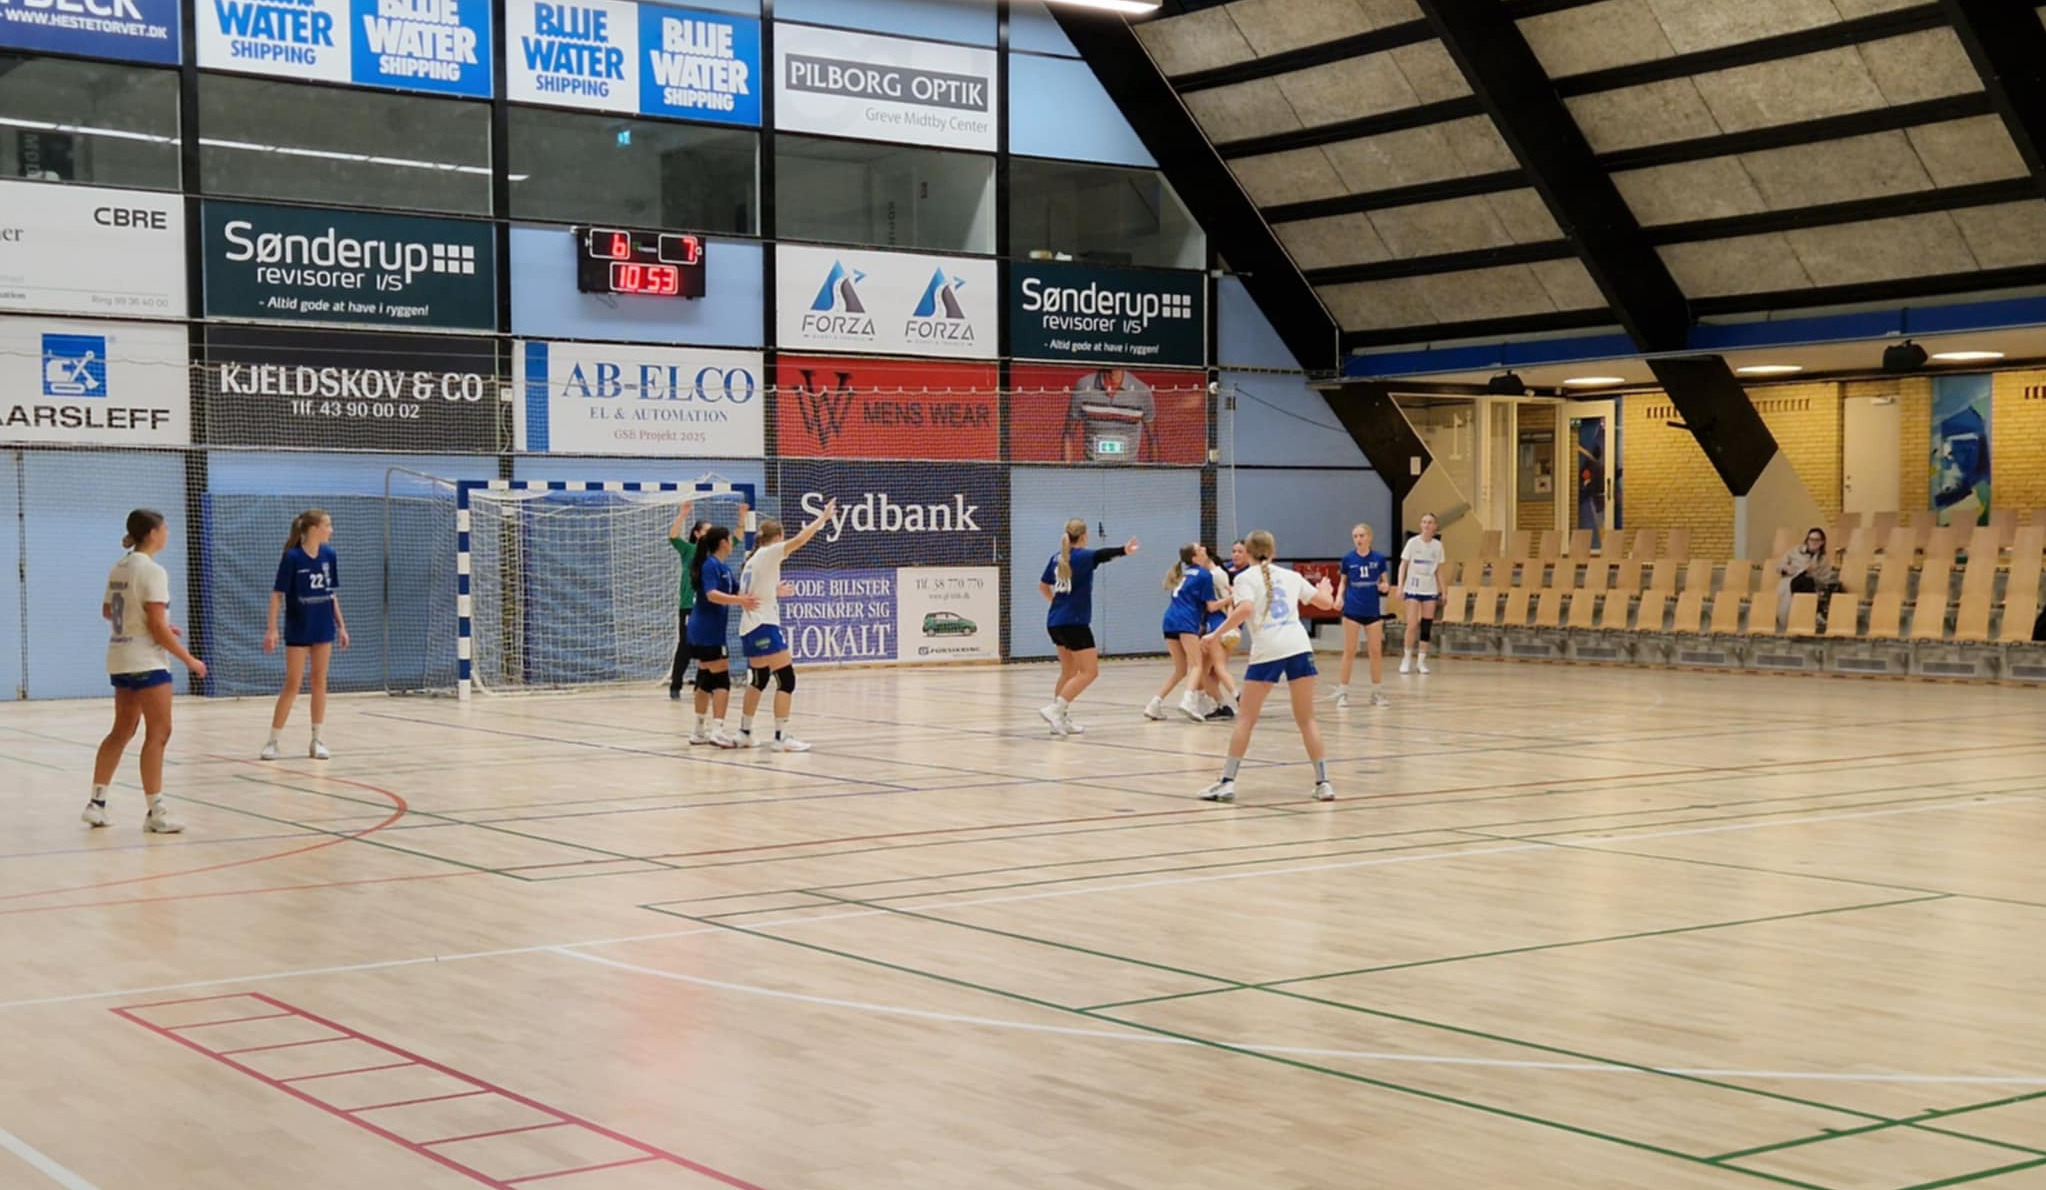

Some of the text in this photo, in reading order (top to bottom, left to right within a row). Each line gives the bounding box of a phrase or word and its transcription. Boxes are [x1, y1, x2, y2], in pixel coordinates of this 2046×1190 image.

[214, 0, 334, 47] WATER
[534, 2, 609, 43] BLUE
[362, 15, 478, 64] WATER
[662, 17, 733, 58] BLUE
[231, 39, 316, 65] SHIPPING
[521, 35, 624, 80] WATER
[379, 56, 461, 82] SHIPPING
[650, 50, 749, 95] WATER
[536, 74, 610, 97] SHIPPING
[791, 61, 984, 106] PILBORG OPTIK
[663, 88, 734, 112] SHIPPING
[865, 107, 988, 134] Greve Midtby Center
[93, 207, 167, 230] CBRE
[0, 227, 24, 242] er
[612, 233, 627, 257] 6
[224, 220, 428, 284] Sønderup
[683, 238, 695, 261] 7
[256, 266, 402, 292] revisorer I/S
[155, 298, 168, 308] 00
[267, 296, 297, 310] Altid
[300, 299, 330, 314] gode
[332, 301, 345, 313] at
[348, 299, 376, 314] have
[386, 304, 429, 318] ryggen!
[1021, 277, 1160, 328] Sønderup
[802, 314, 876, 335] FORZA
[905, 320, 975, 341] FORZA
[1043, 315, 1142, 334] revisorer I/S
[1049, 339, 1070, 350] Altid
[1071, 341, 1092, 352] gode
[1093, 342, 1103, 351] at
[1104, 341, 1123, 352] have
[1129, 343, 1160, 355] ryggen!
[220, 363, 484, 402] KJELDSKOV & CO
[562, 361, 755, 405] AB-ELCO
[0, 405, 170, 429] ARSLEFF
[320, 402, 341, 417] 43
[346, 402, 368, 417] 90
[372, 403, 394, 418] 00
[398, 403, 420, 419] 02
[590, 406, 729, 422] EL & AUTOMATION
[863, 401, 991, 428] MENS WEAR
[639, 430, 677, 443] Projekt
[680, 431, 707, 443] 2025
[800, 492, 982, 543] Sydbank
[310, 573, 324, 589] 22
[1359, 565, 1369, 578] 11
[829, 578, 890, 597] BILISTER
[786, 601, 890, 619] FORSIKRER SIG
[787, 624, 890, 659] LOKALT
